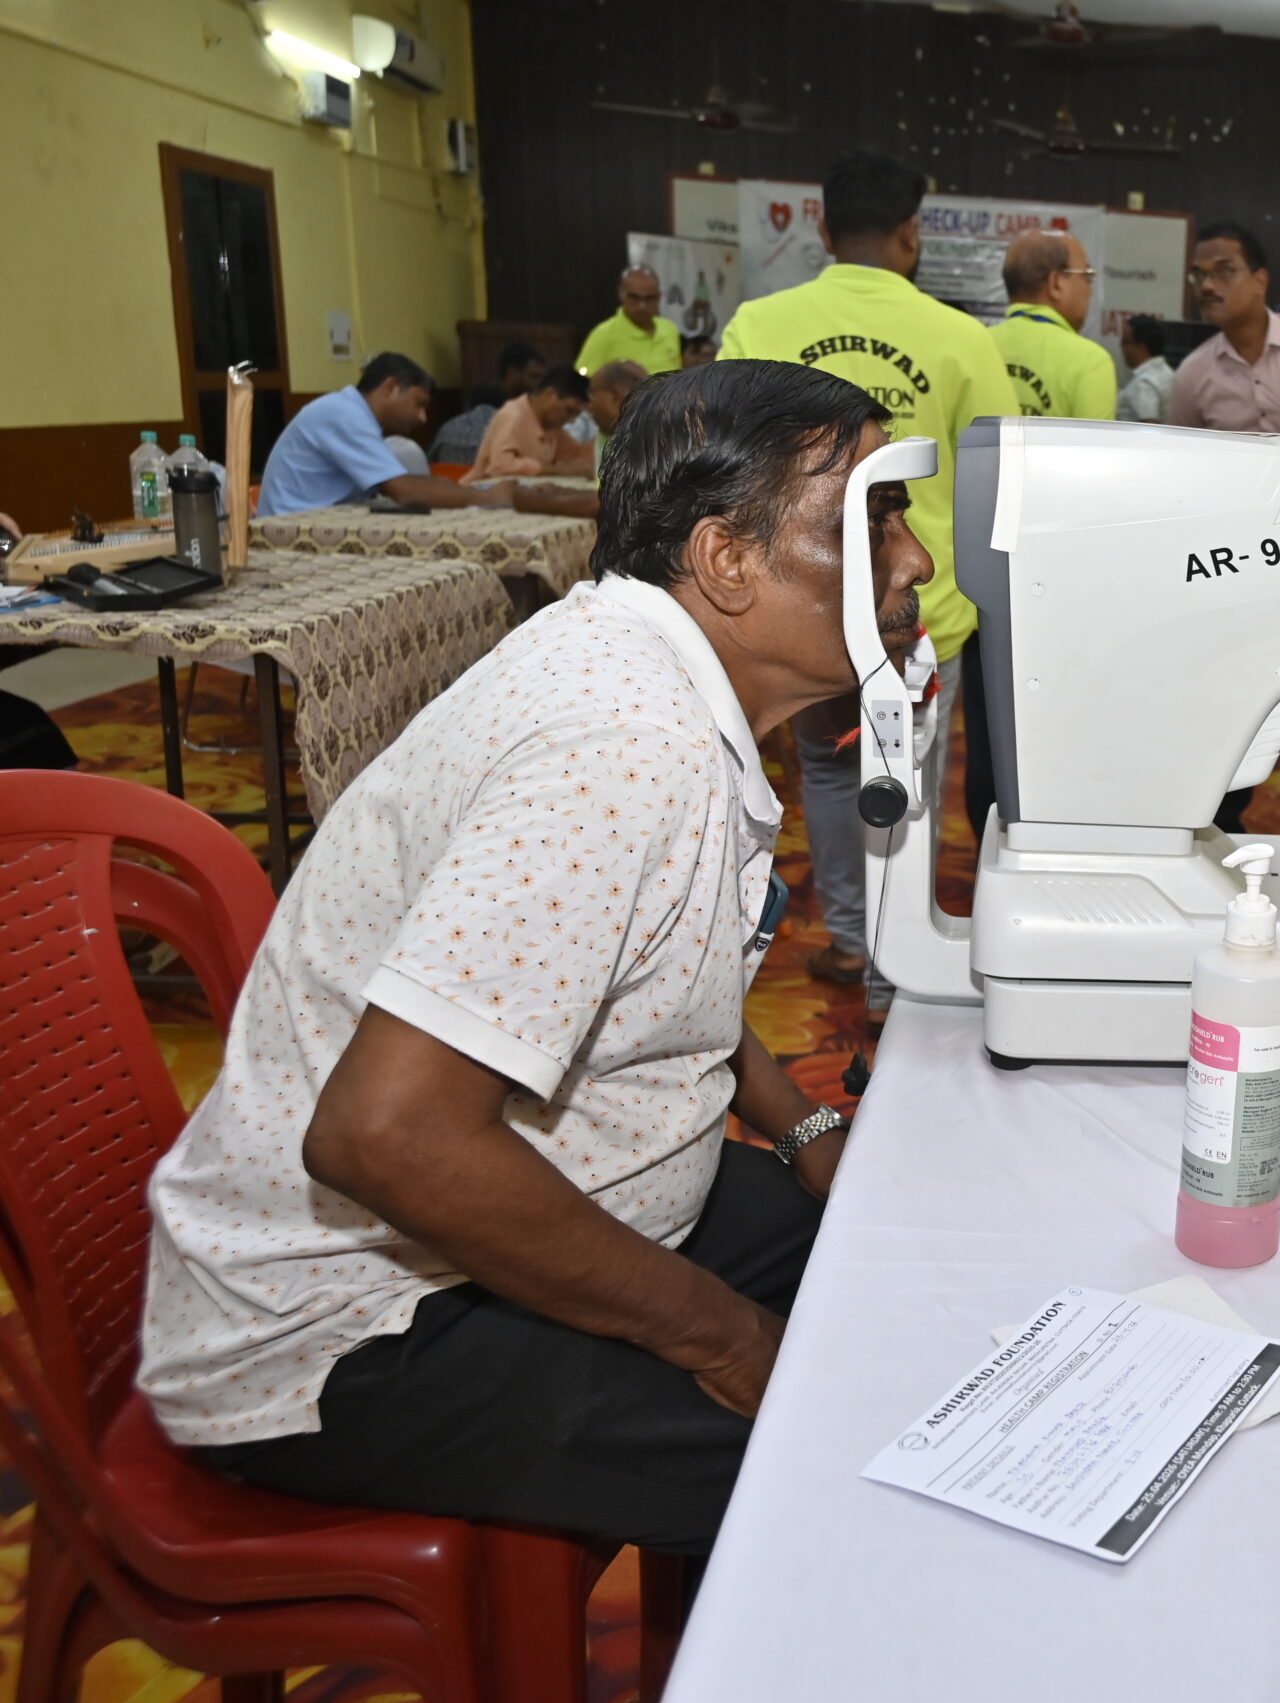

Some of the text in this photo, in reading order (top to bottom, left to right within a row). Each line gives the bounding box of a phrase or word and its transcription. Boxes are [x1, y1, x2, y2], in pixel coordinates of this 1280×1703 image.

[920, 207, 991, 233] HECK-UP
[799, 334, 931, 395] SHIRWAD
[867, 386, 916, 409] TION
[1260, 538, 1280, 566] 9
[926, 1368, 994, 1427] ASHIRWAD
[992, 1302, 1063, 1366] FOUNDATION
[1000, 1408, 1029, 1433] HEALTH
[1024, 1389, 1049, 1408] CAMP
[1043, 1351, 1088, 1390] REGISTRATION
[1125, 1502, 1146, 1521] Date:
[1141, 1464, 1177, 1503] 25.04.2026
[1203, 1410, 1224, 1426] Time:
[1222, 1393, 1236, 1405] AM
[1236, 1374, 1252, 1388] 2:30
[1247, 1364, 1261, 1375] PM
[1177, 1460, 1197, 1479] OYEA
[1191, 1434, 1223, 1460] Mandap,
